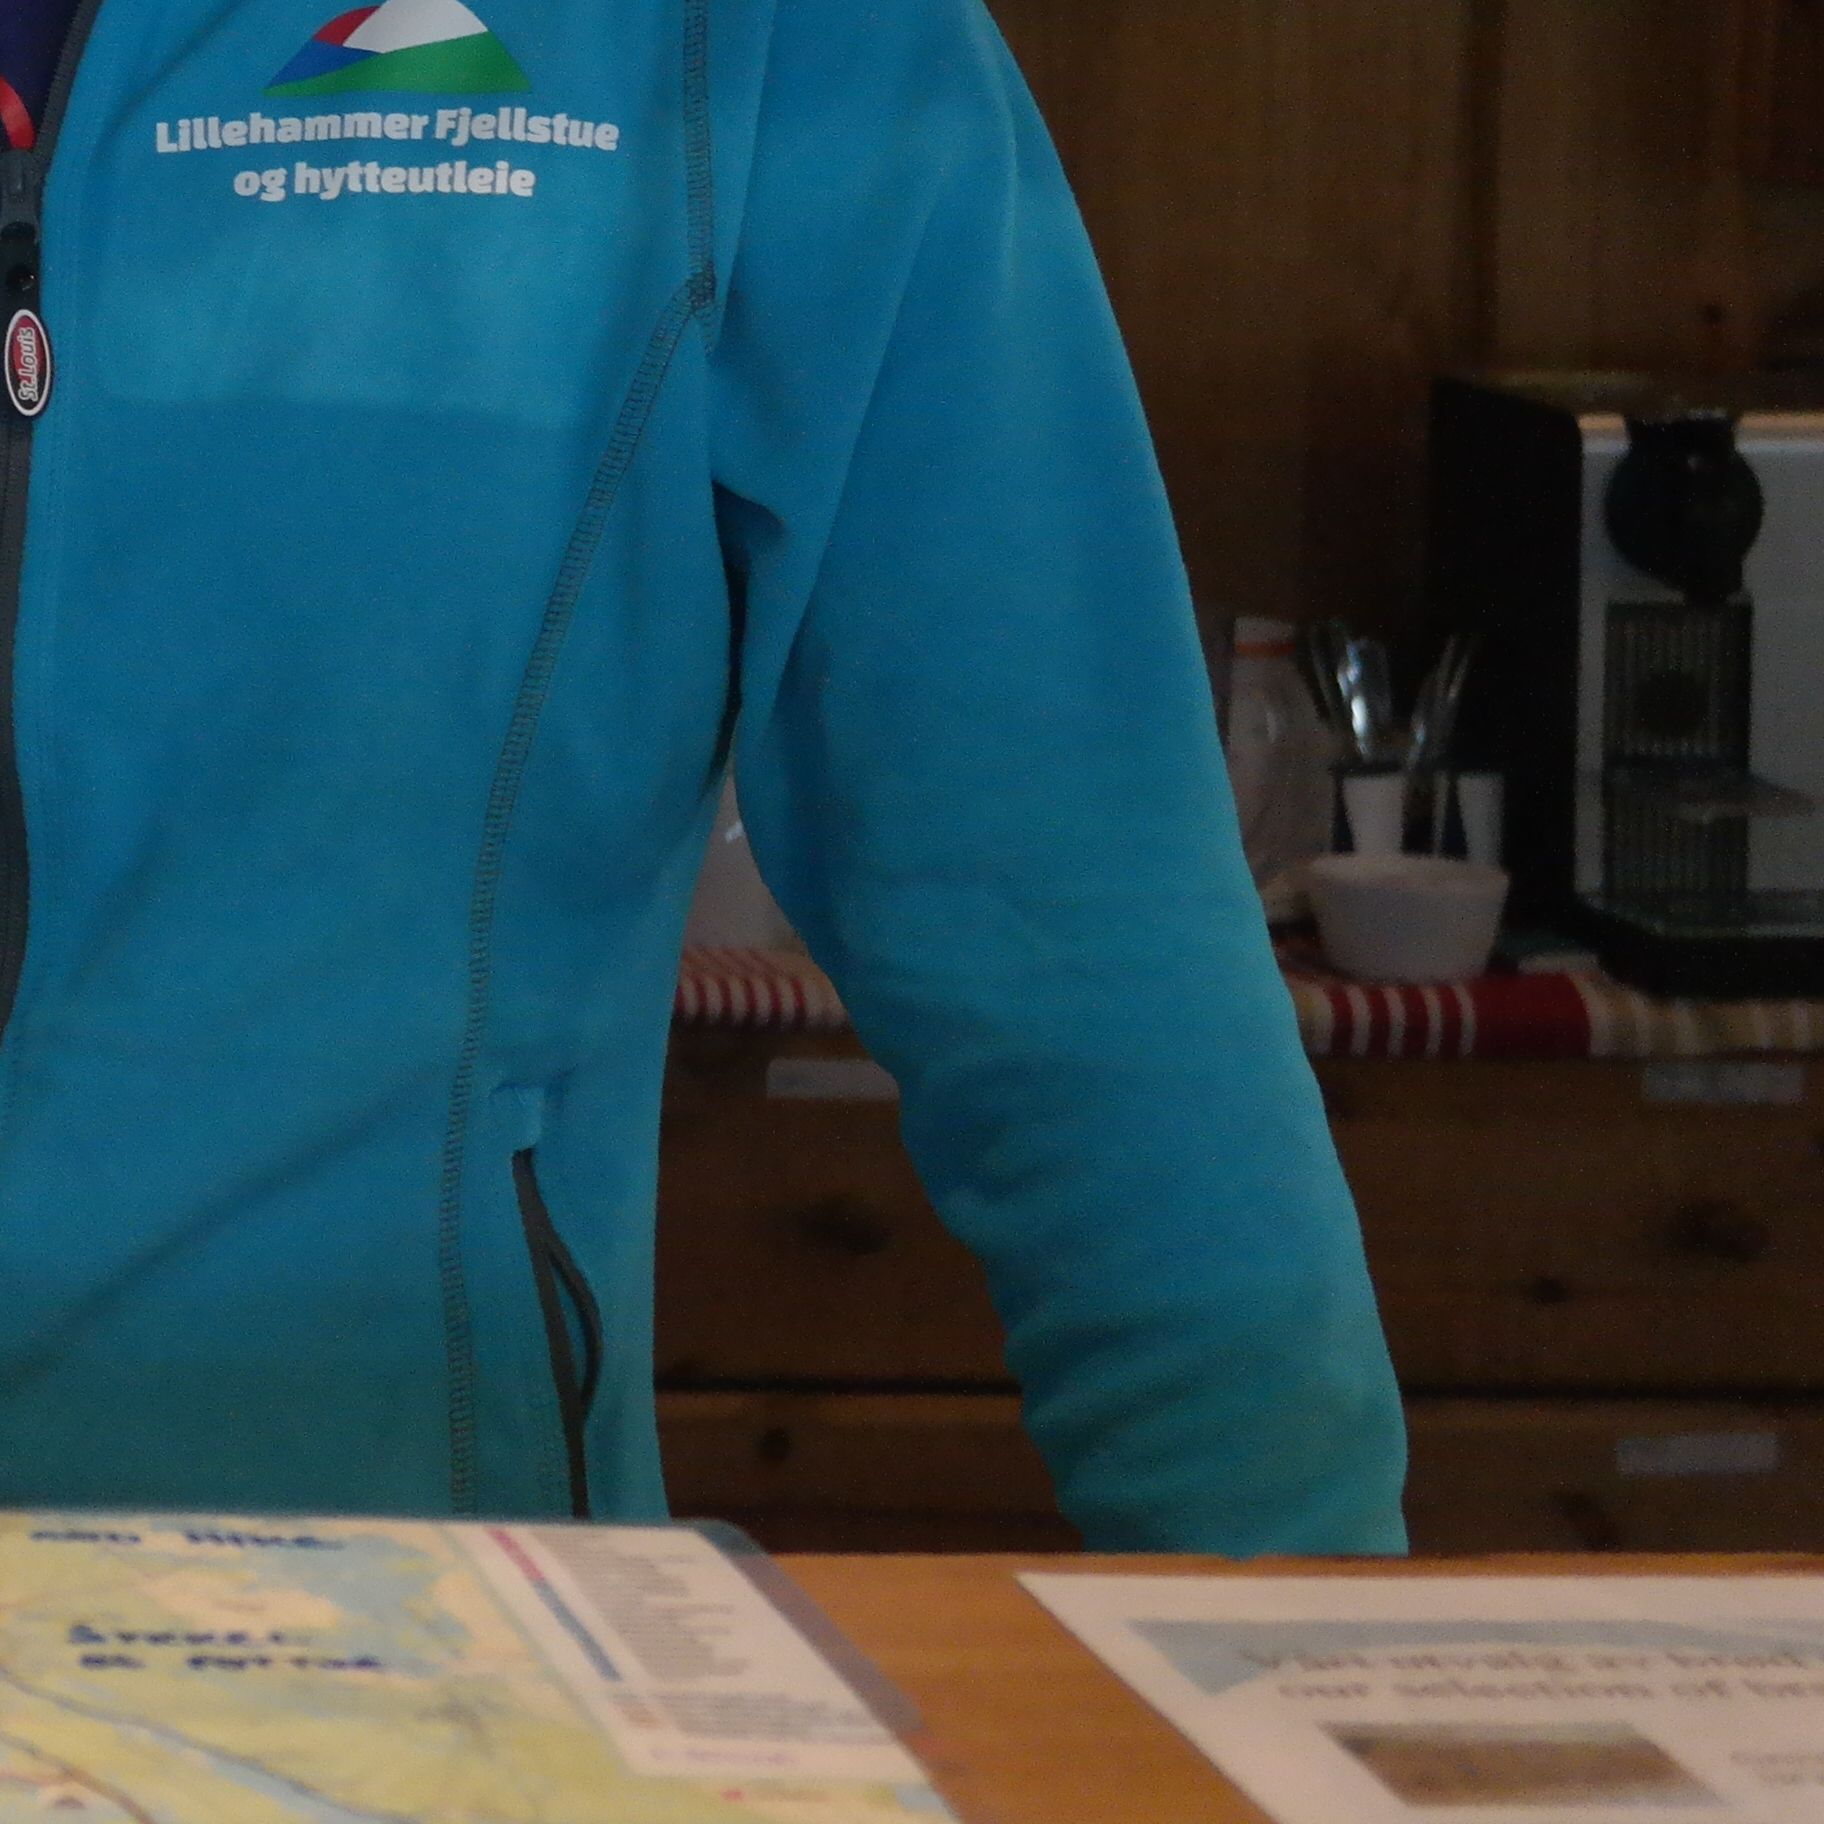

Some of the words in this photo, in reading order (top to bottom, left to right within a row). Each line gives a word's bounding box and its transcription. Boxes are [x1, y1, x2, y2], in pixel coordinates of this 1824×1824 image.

[154, 107, 429, 154] Lillehammer
[434, 106, 621, 152] Fjellstue
[232, 164, 288, 202] og
[293, 159, 537, 201] hytteutleie
